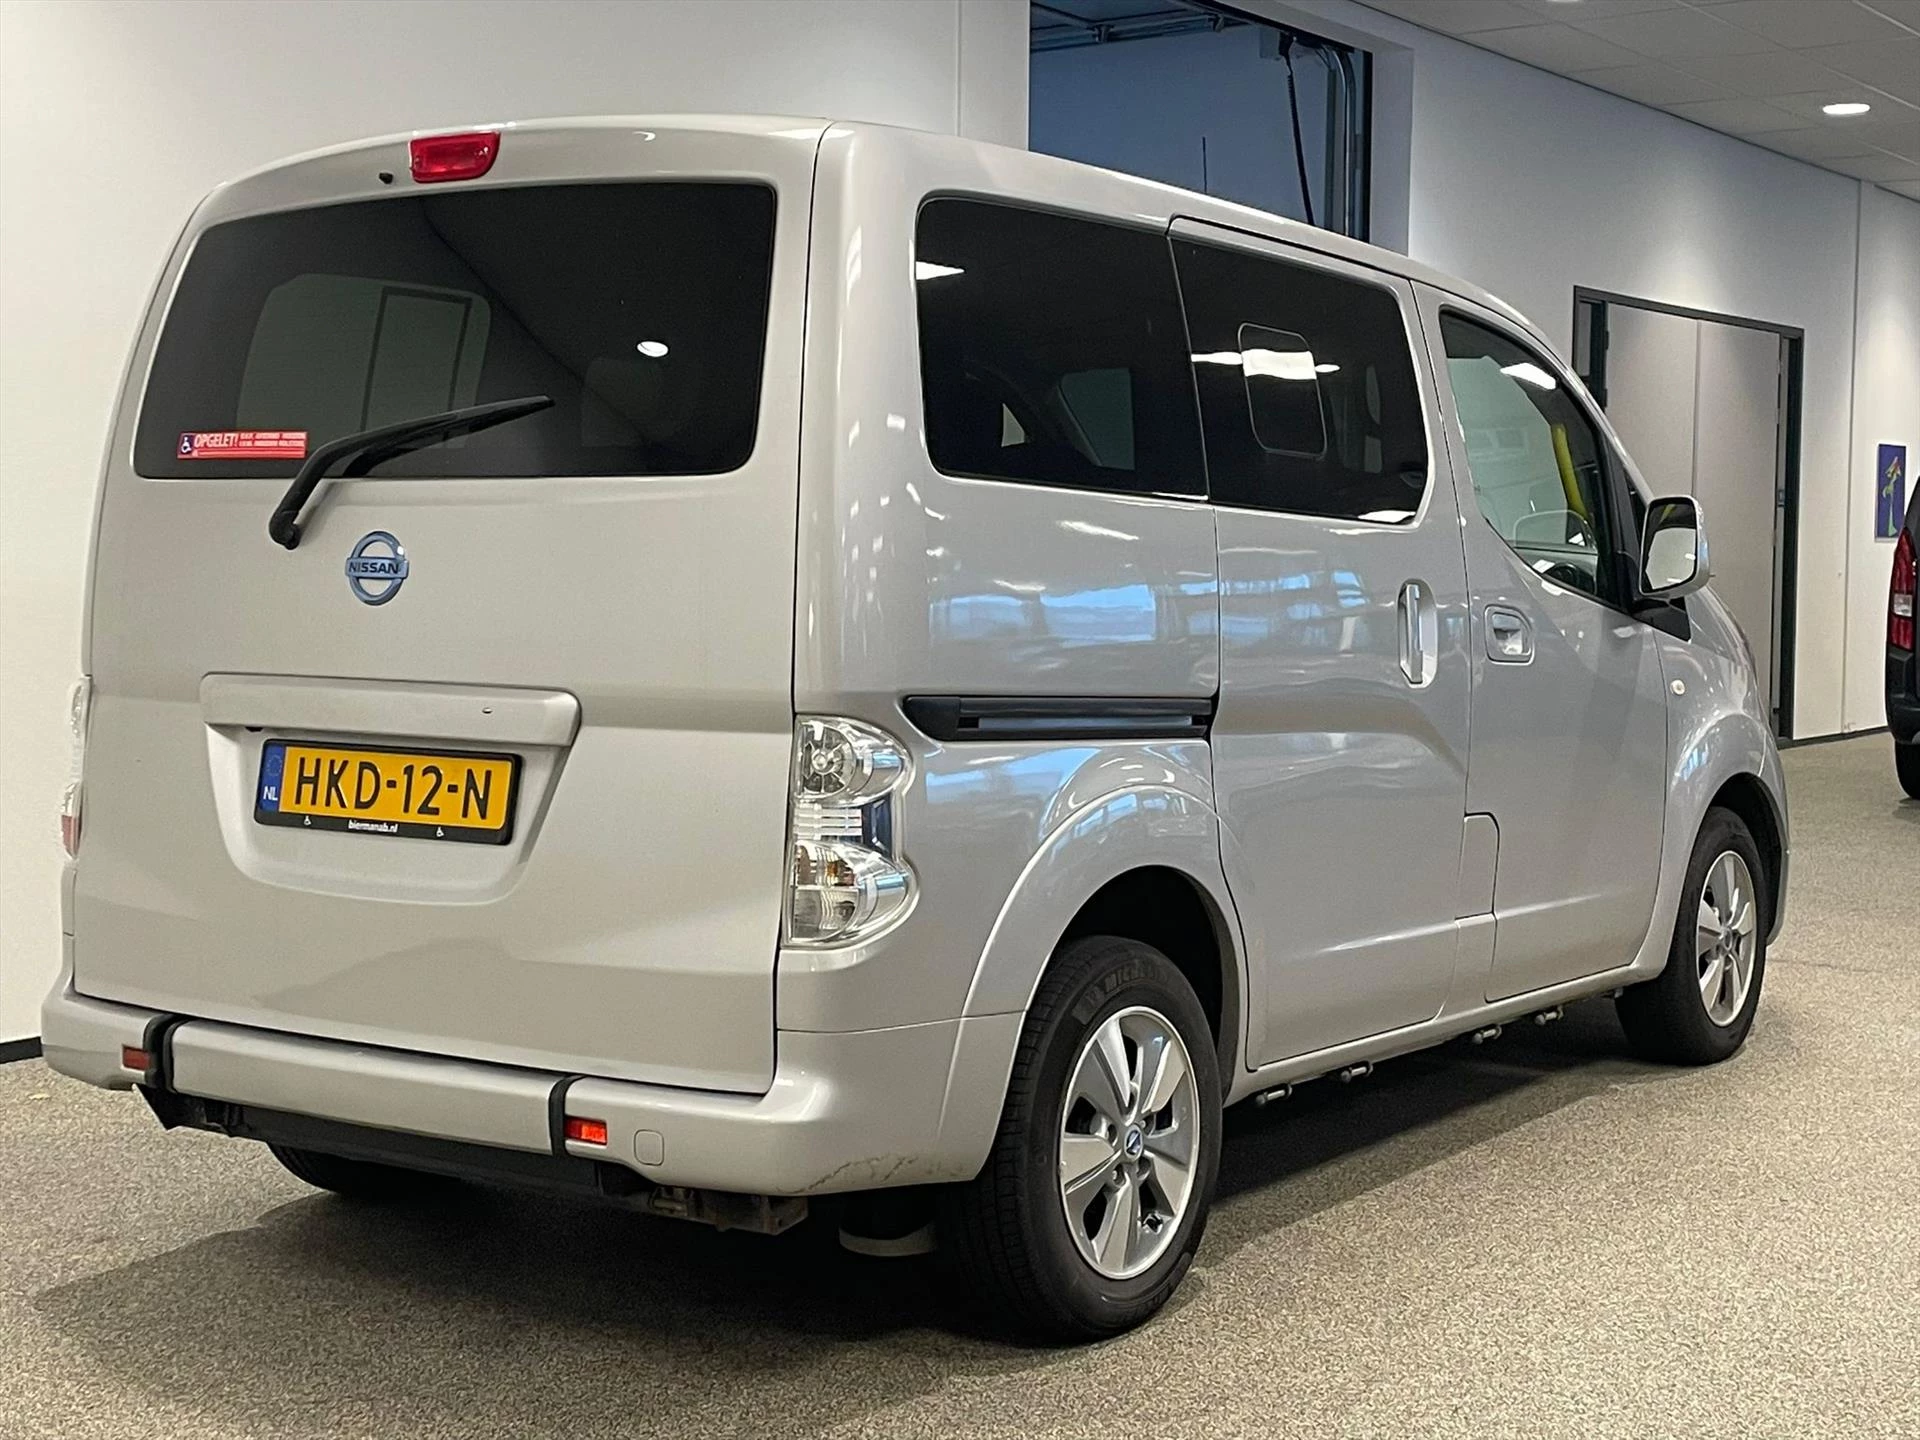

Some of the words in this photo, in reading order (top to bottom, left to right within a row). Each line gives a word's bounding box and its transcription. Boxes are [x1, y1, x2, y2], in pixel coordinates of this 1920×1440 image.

[194, 432, 239, 448] OPGELET!
[348, 562, 399, 574] NISSAN
[263, 786, 278, 801] NL
[295, 757, 492, 820] HKD-12-N
